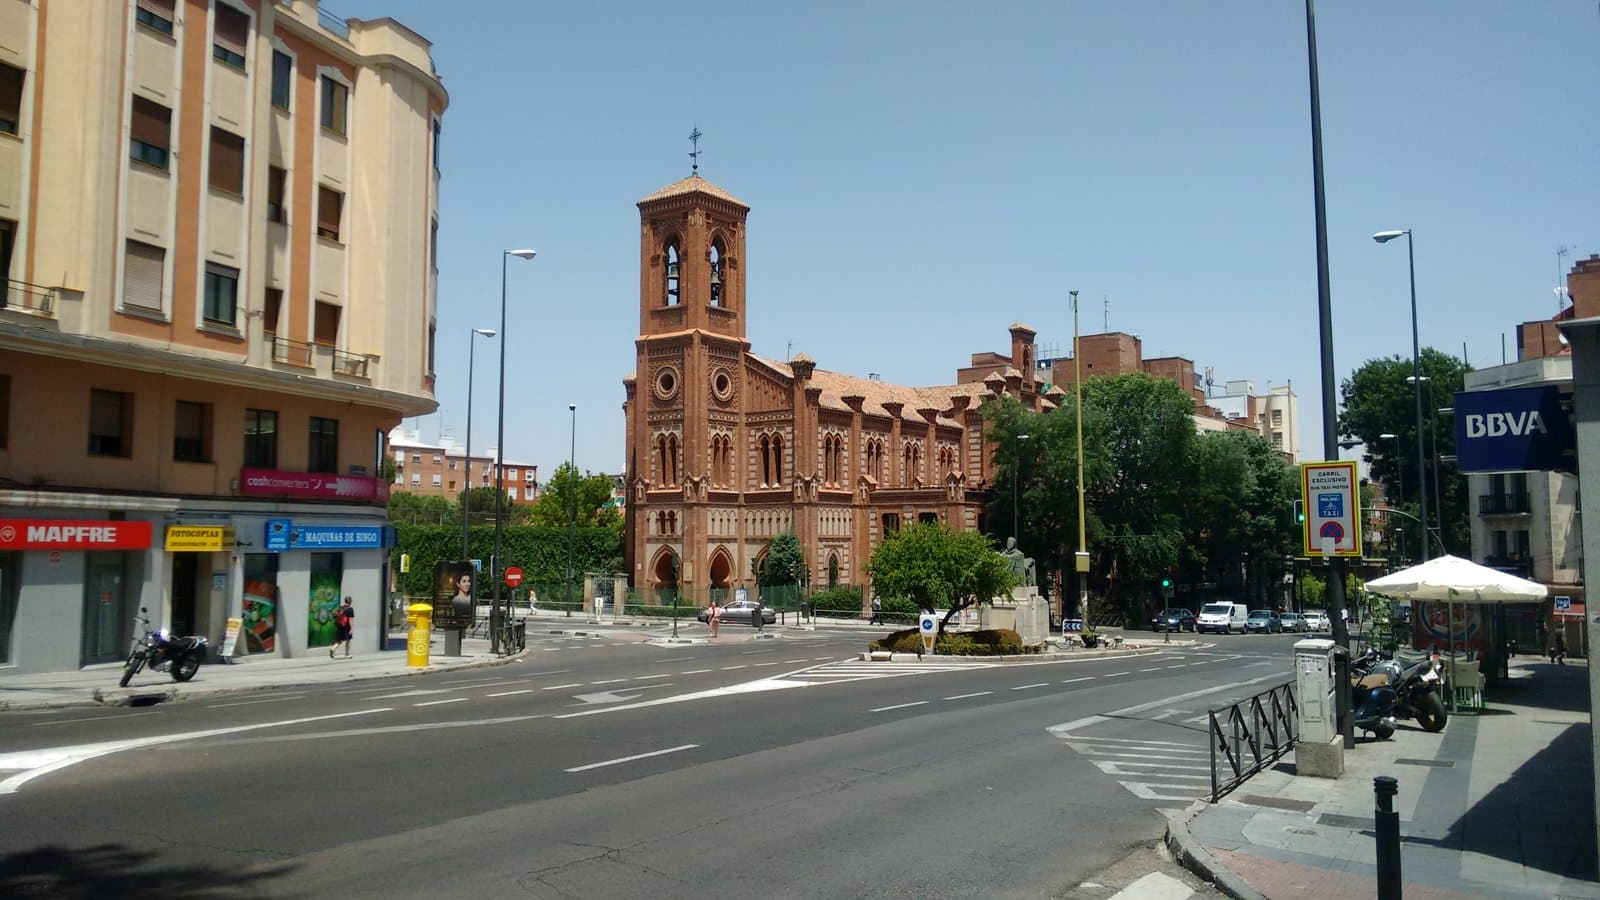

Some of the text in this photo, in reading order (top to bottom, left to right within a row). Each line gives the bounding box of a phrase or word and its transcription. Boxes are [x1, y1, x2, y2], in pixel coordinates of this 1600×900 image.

[1466, 411, 1548, 438] BBVA
[27, 526, 117, 542] MAPFRE
[345, 532, 354, 543] DE
[356, 532, 377, 543] BINGO
